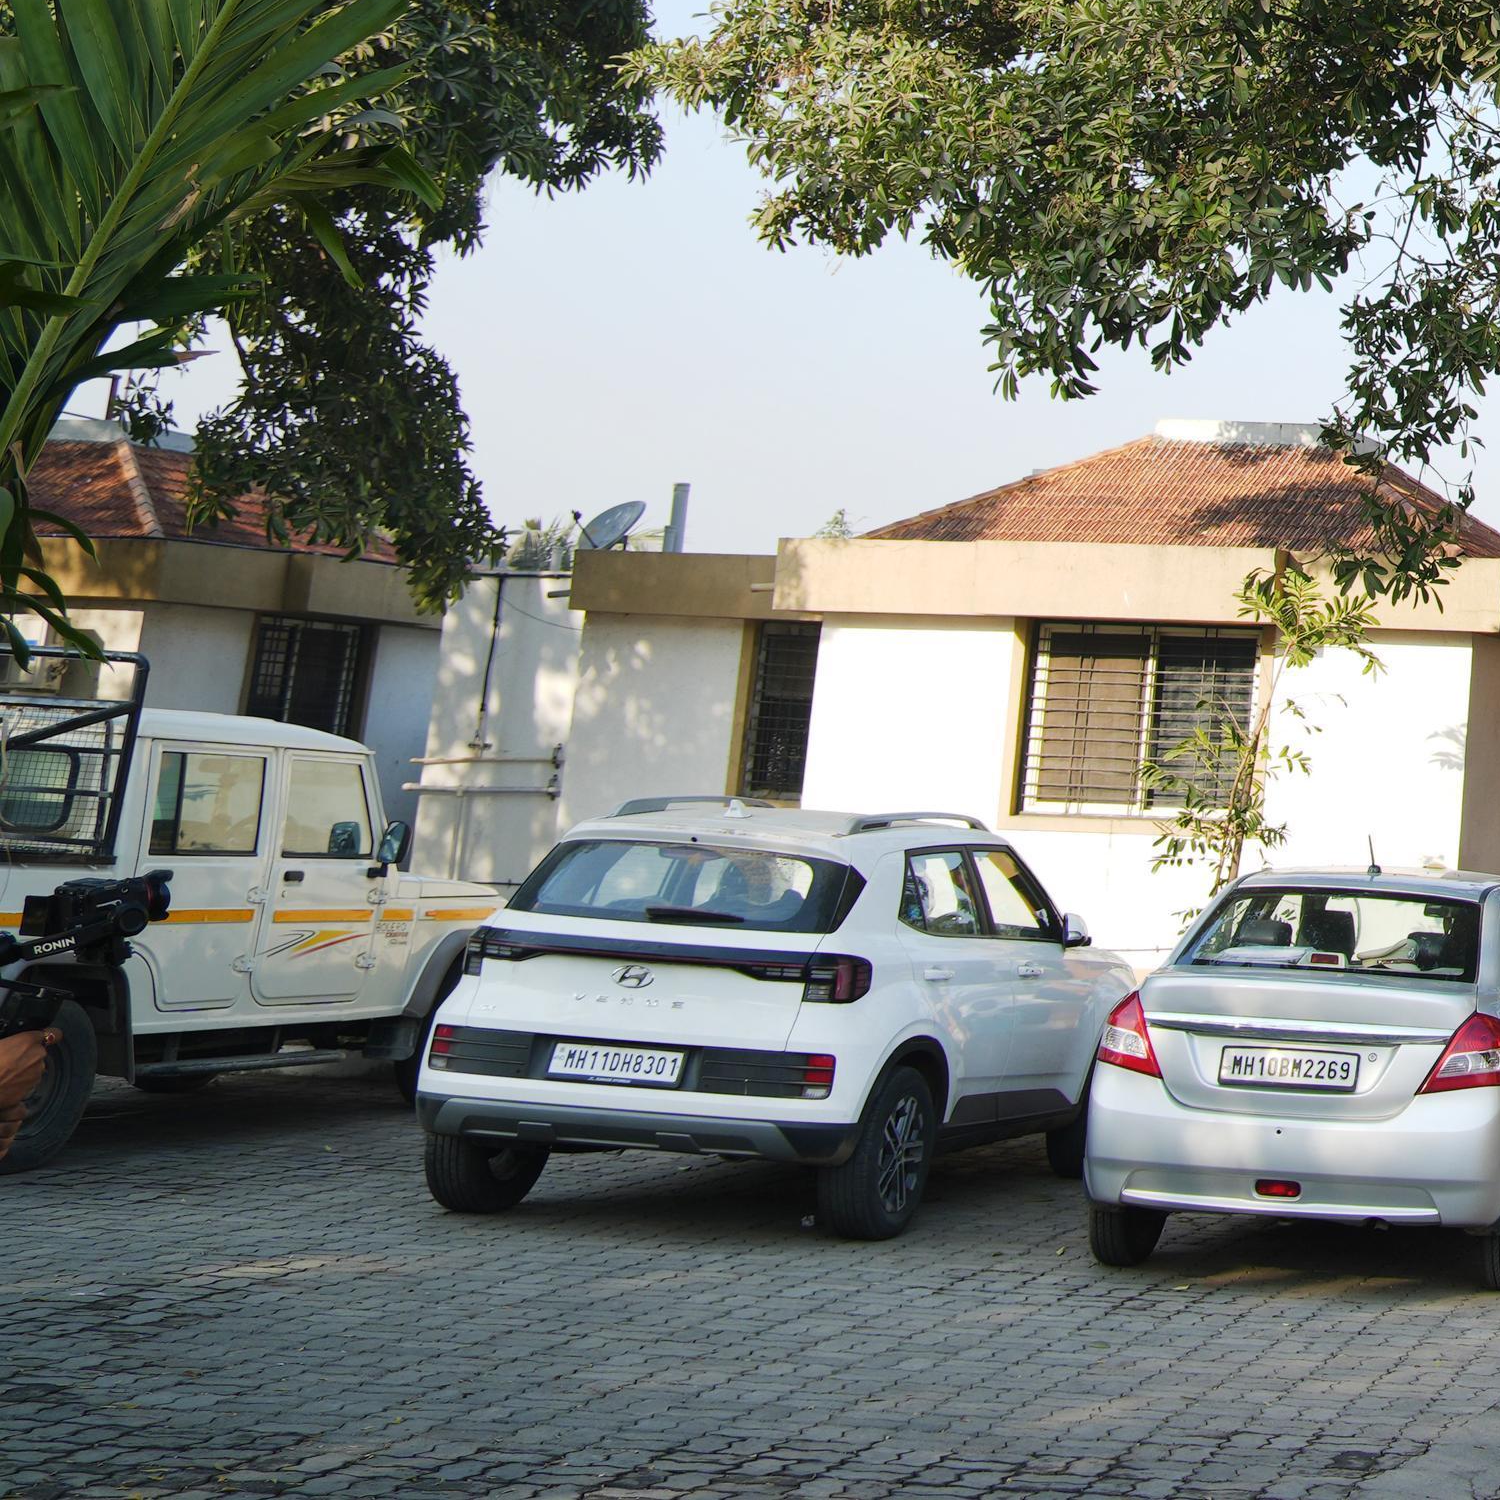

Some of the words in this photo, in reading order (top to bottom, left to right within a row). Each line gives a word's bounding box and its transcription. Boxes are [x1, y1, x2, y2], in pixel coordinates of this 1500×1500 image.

[34, 936, 76, 955] RONIN
[573, 992, 685, 1009] VENUE
[564, 1049, 679, 1077] MH11DH8301
[1231, 1055, 1350, 1080] MH10BM2269
